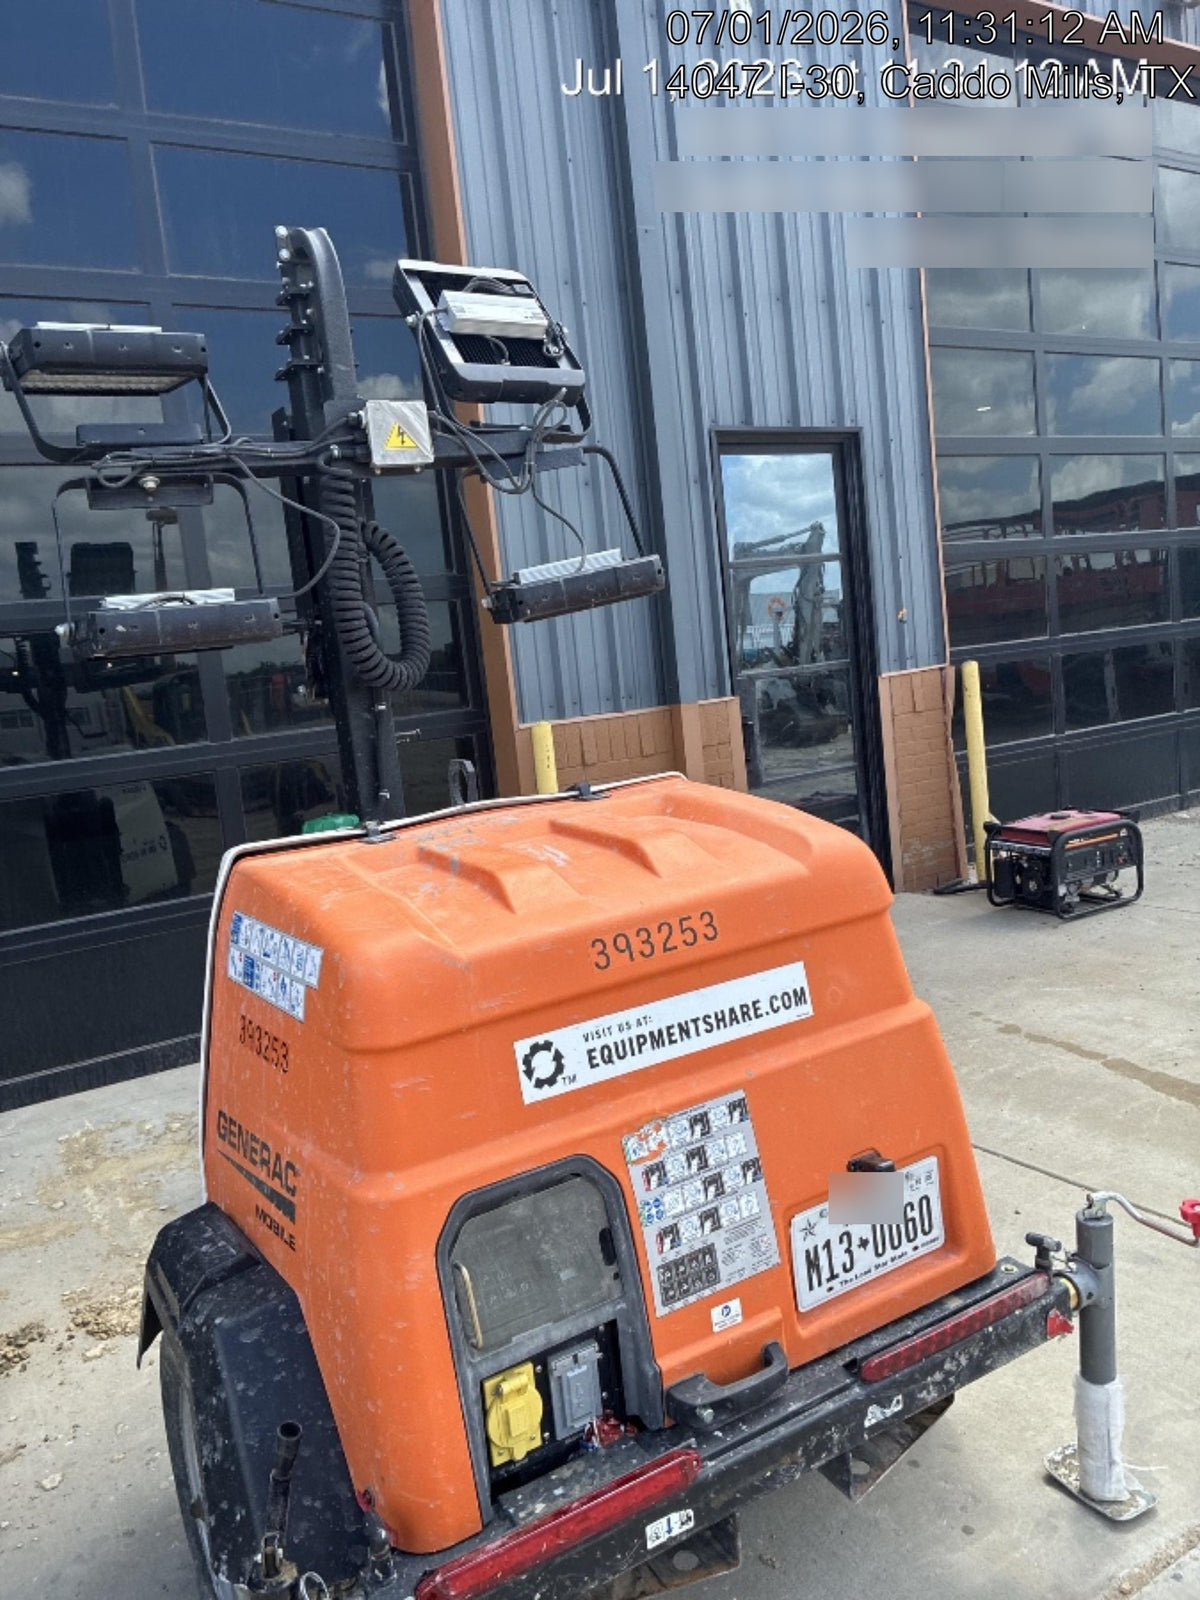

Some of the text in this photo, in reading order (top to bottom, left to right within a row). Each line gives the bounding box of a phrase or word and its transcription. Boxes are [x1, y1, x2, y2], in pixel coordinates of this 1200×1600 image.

[590, 910, 719, 970] 393253
[239, 1014, 289, 1074] 393253
[583, 1025, 612, 1042] VISIT
[617, 1021, 632, 1034] US
[586, 985, 808, 1070] EQUIPMENTSHARE.COM
[217, 1110, 296, 1198] GENERAC
[255, 1203, 297, 1252] MOBILE
